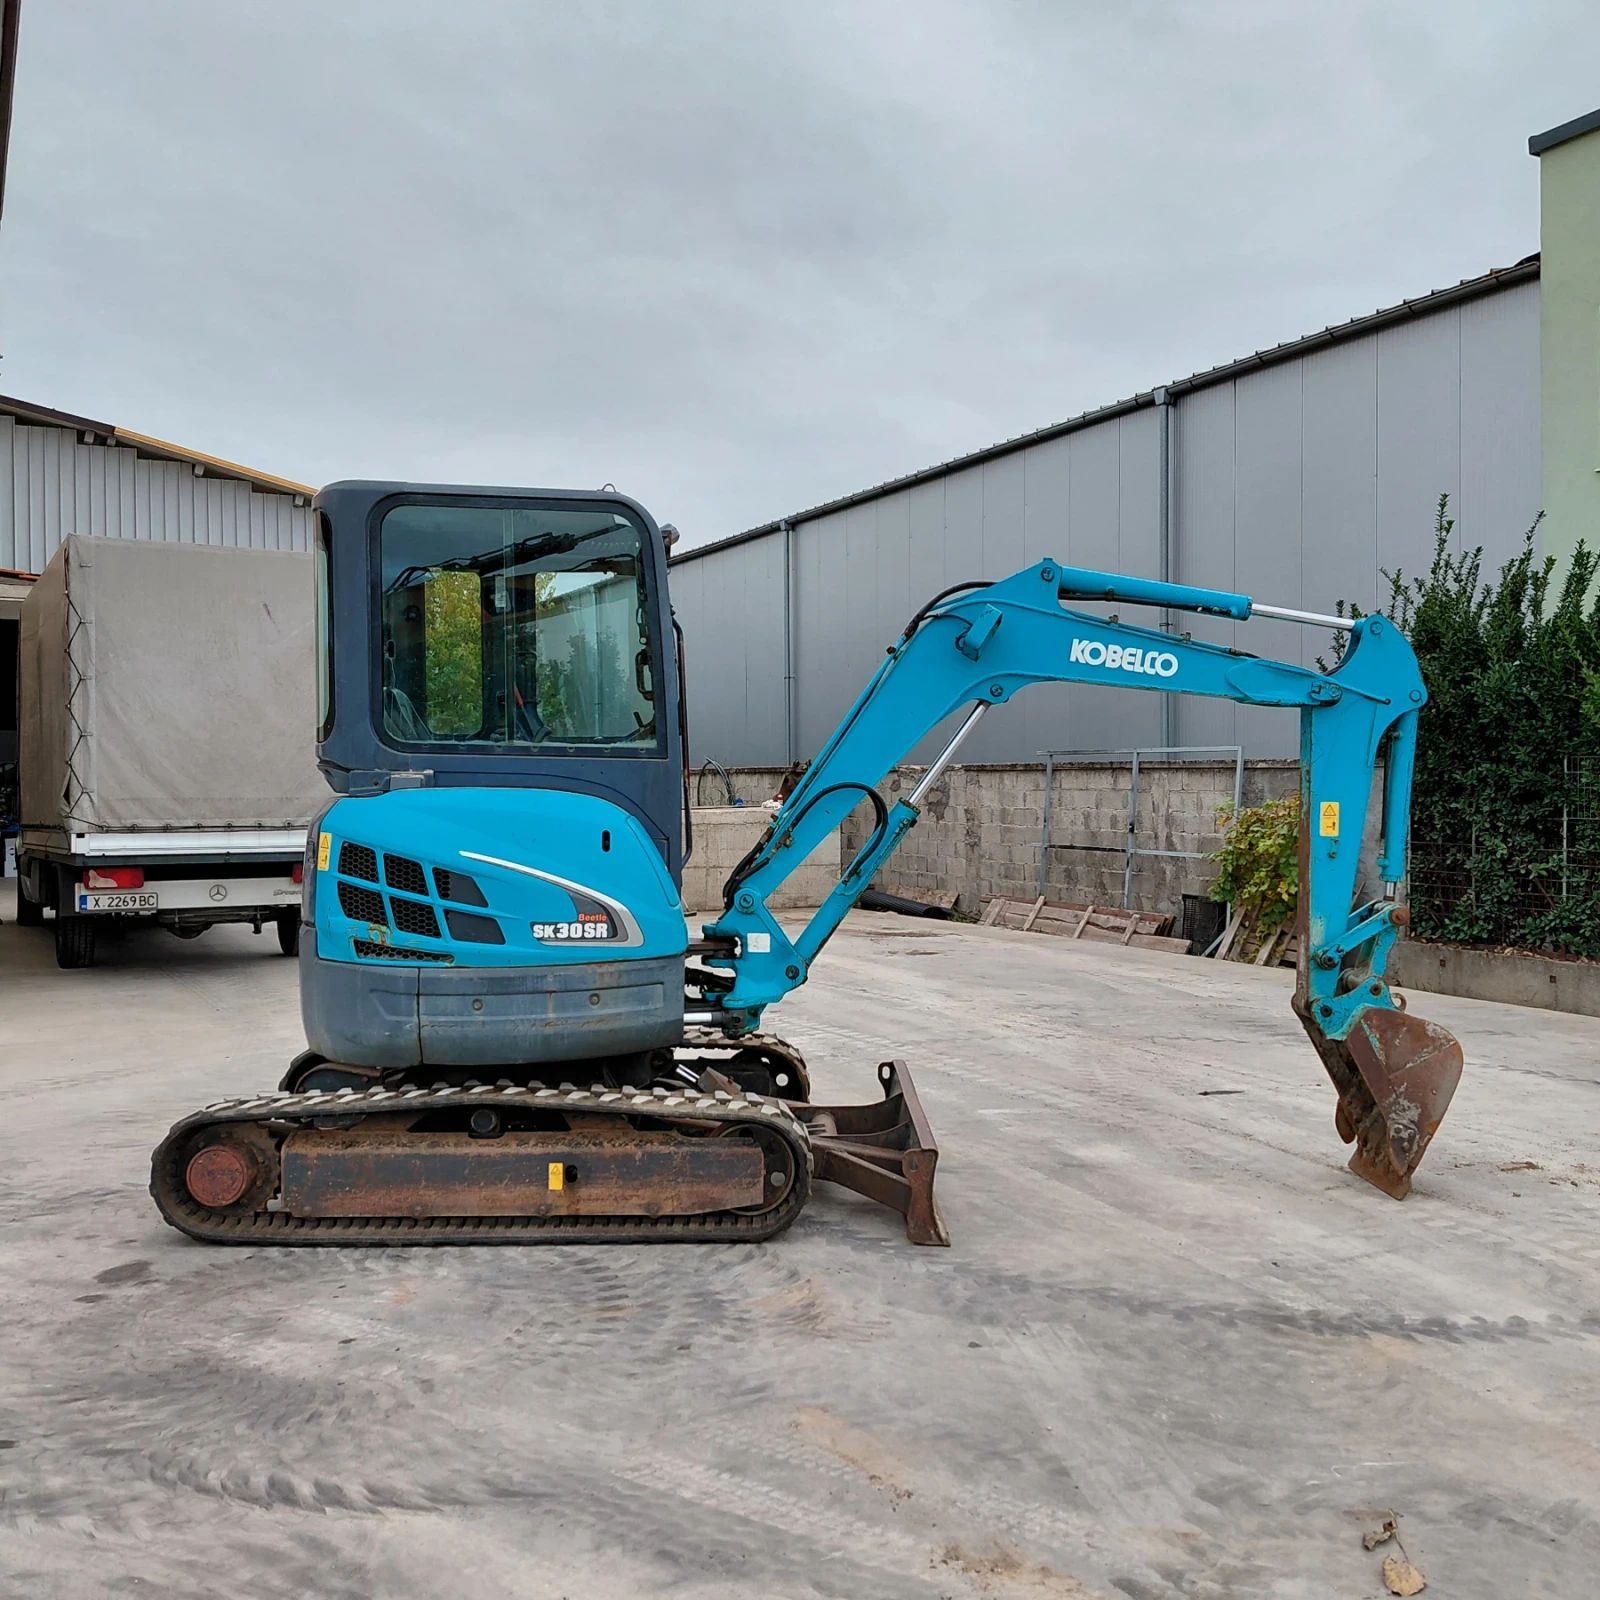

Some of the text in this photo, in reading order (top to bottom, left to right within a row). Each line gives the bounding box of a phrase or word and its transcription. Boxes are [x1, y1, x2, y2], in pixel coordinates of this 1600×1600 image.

[1069, 638, 1179, 677] KOBELCO
[93, 895, 155, 908] X 2269 BC
[578, 913, 608, 921] Beetle
[532, 922, 608, 938] SK30SR
